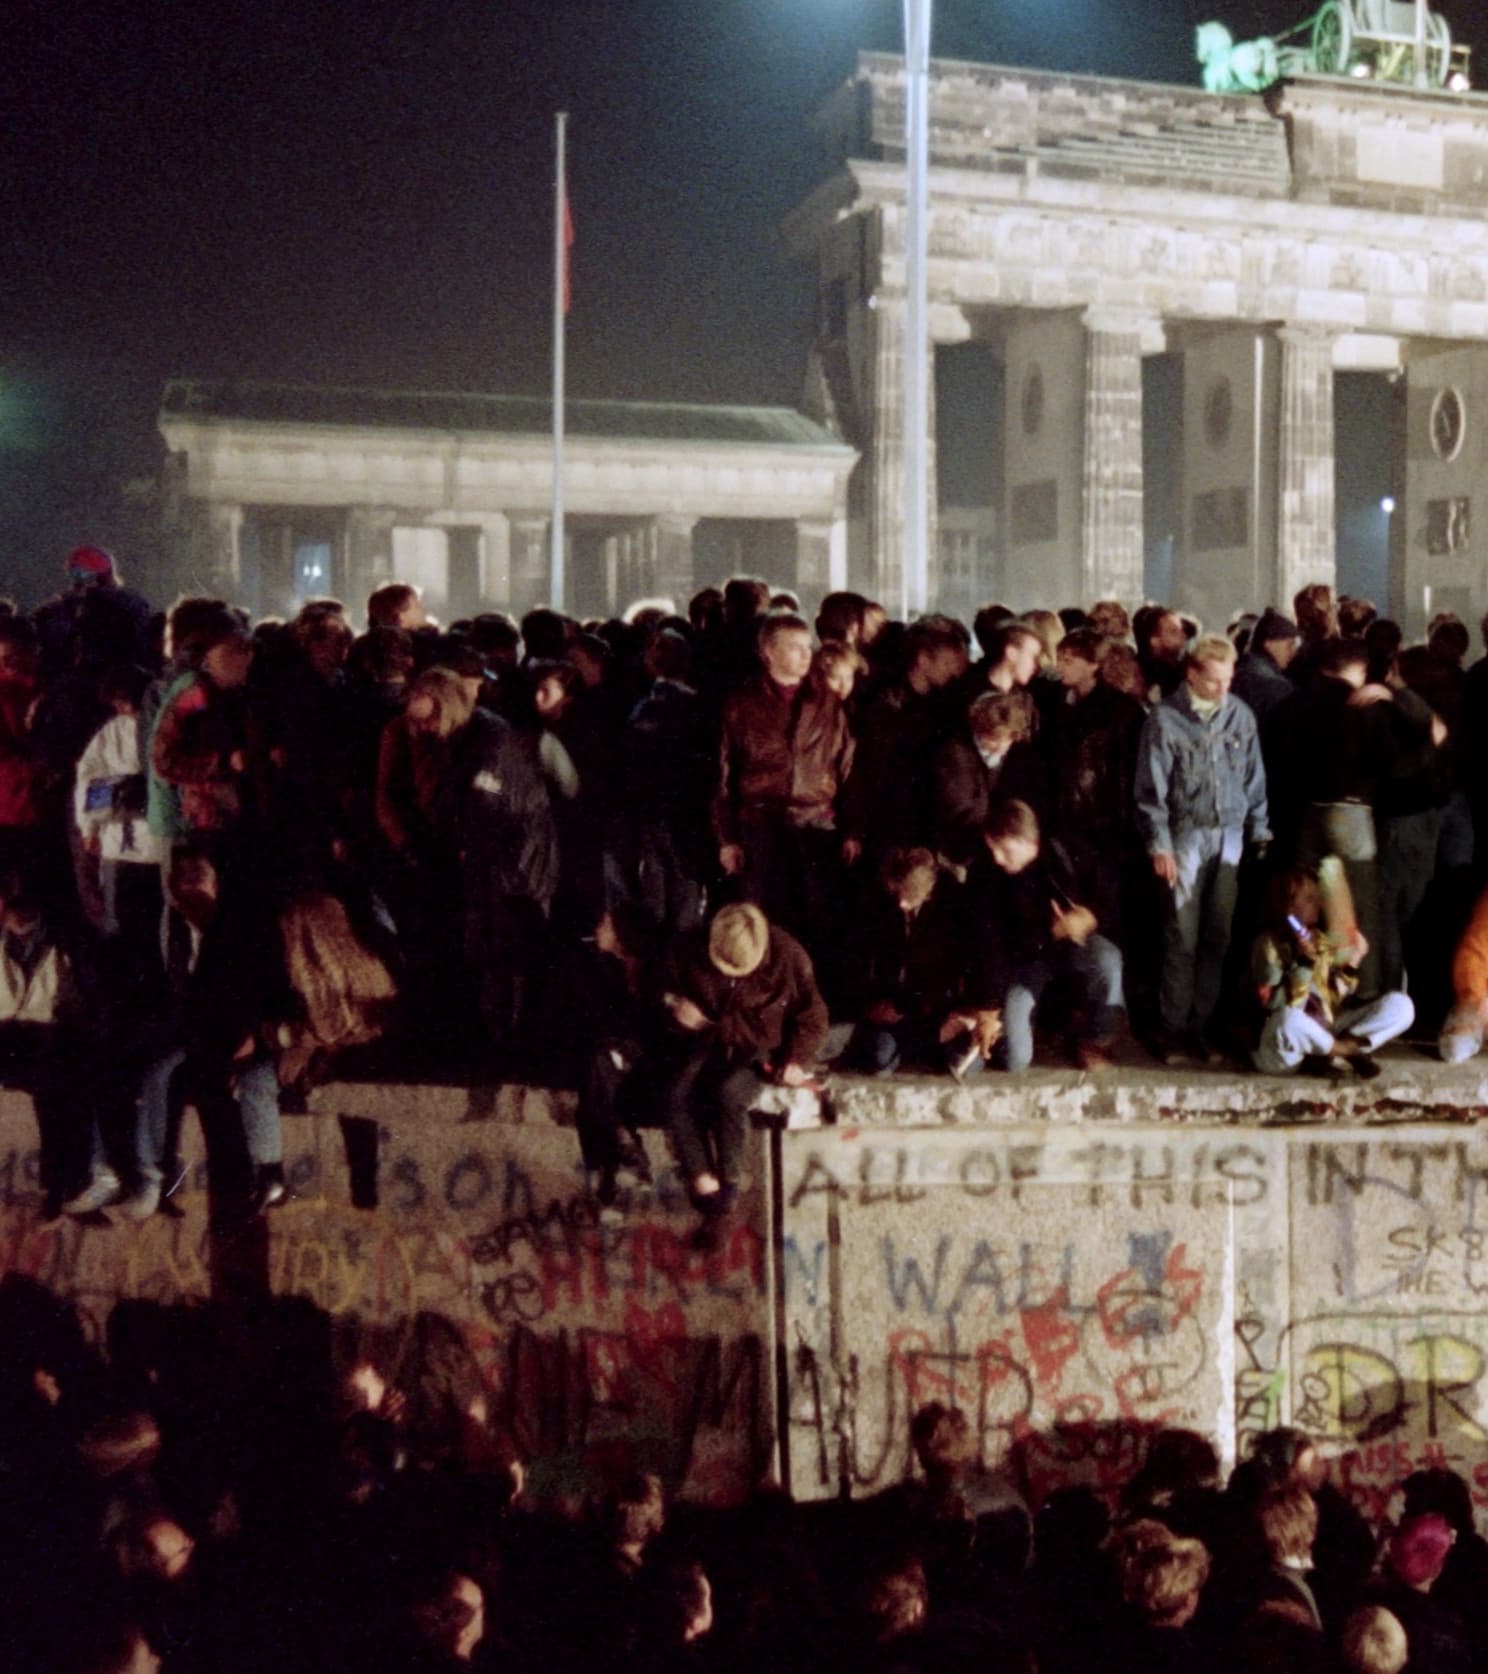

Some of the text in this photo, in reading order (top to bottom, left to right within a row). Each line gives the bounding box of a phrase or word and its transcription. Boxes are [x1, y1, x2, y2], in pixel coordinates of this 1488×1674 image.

[789, 1146, 926, 1208] ALL
[960, 1143, 1040, 1202] OF
[1071, 1142, 1269, 1210] THIS
[1305, 1141, 1368, 1206] IN
